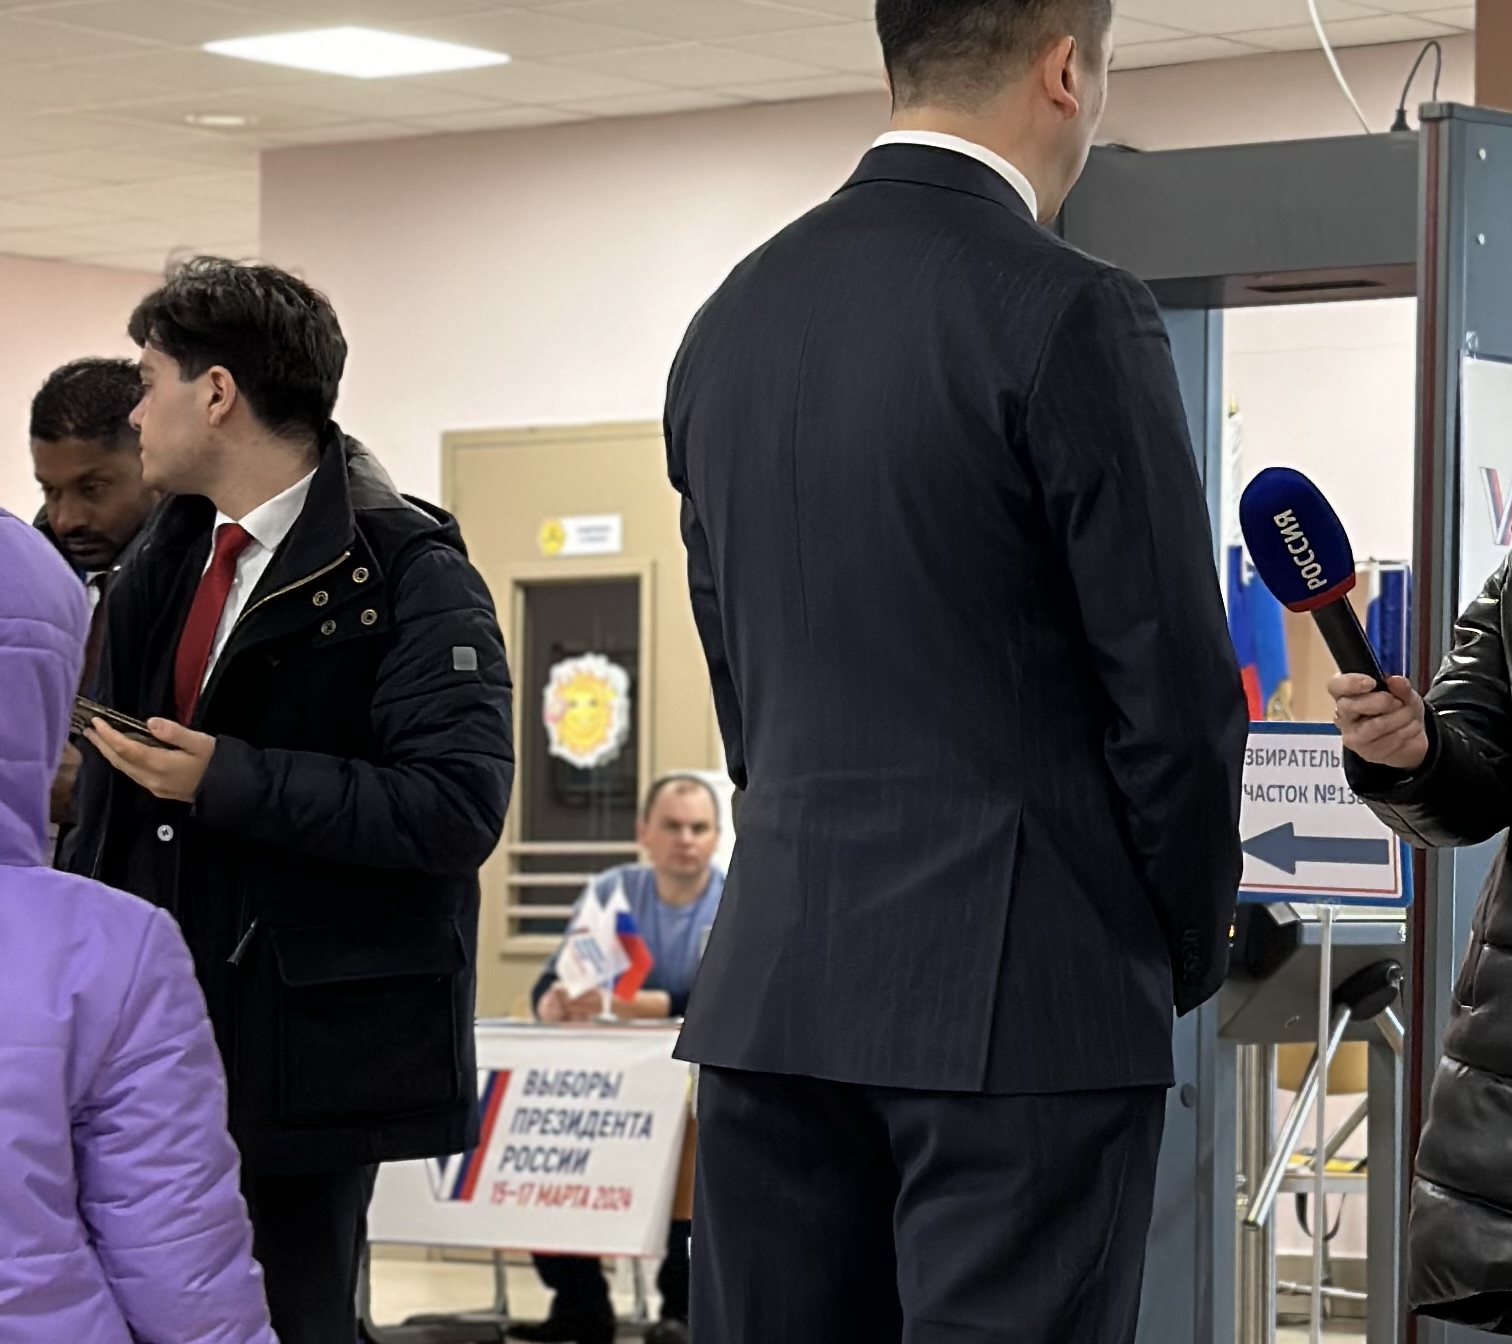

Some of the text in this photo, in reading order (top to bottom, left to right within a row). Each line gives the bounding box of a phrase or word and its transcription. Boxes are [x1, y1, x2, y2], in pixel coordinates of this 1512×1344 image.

[1273, 508, 1328, 590] РОССИЯ
[1245, 747, 1344, 768] ЗБИРАТЕЛЬ
[522, 1068, 624, 1100] ВЫБОРЫ
[509, 1107, 654, 1141] ПРЕЗИДЕНТА
[498, 1144, 592, 1175] РОССИИ
[535, 1182, 591, 1208] МАРТА
[591, 1185, 633, 1211] 2024
